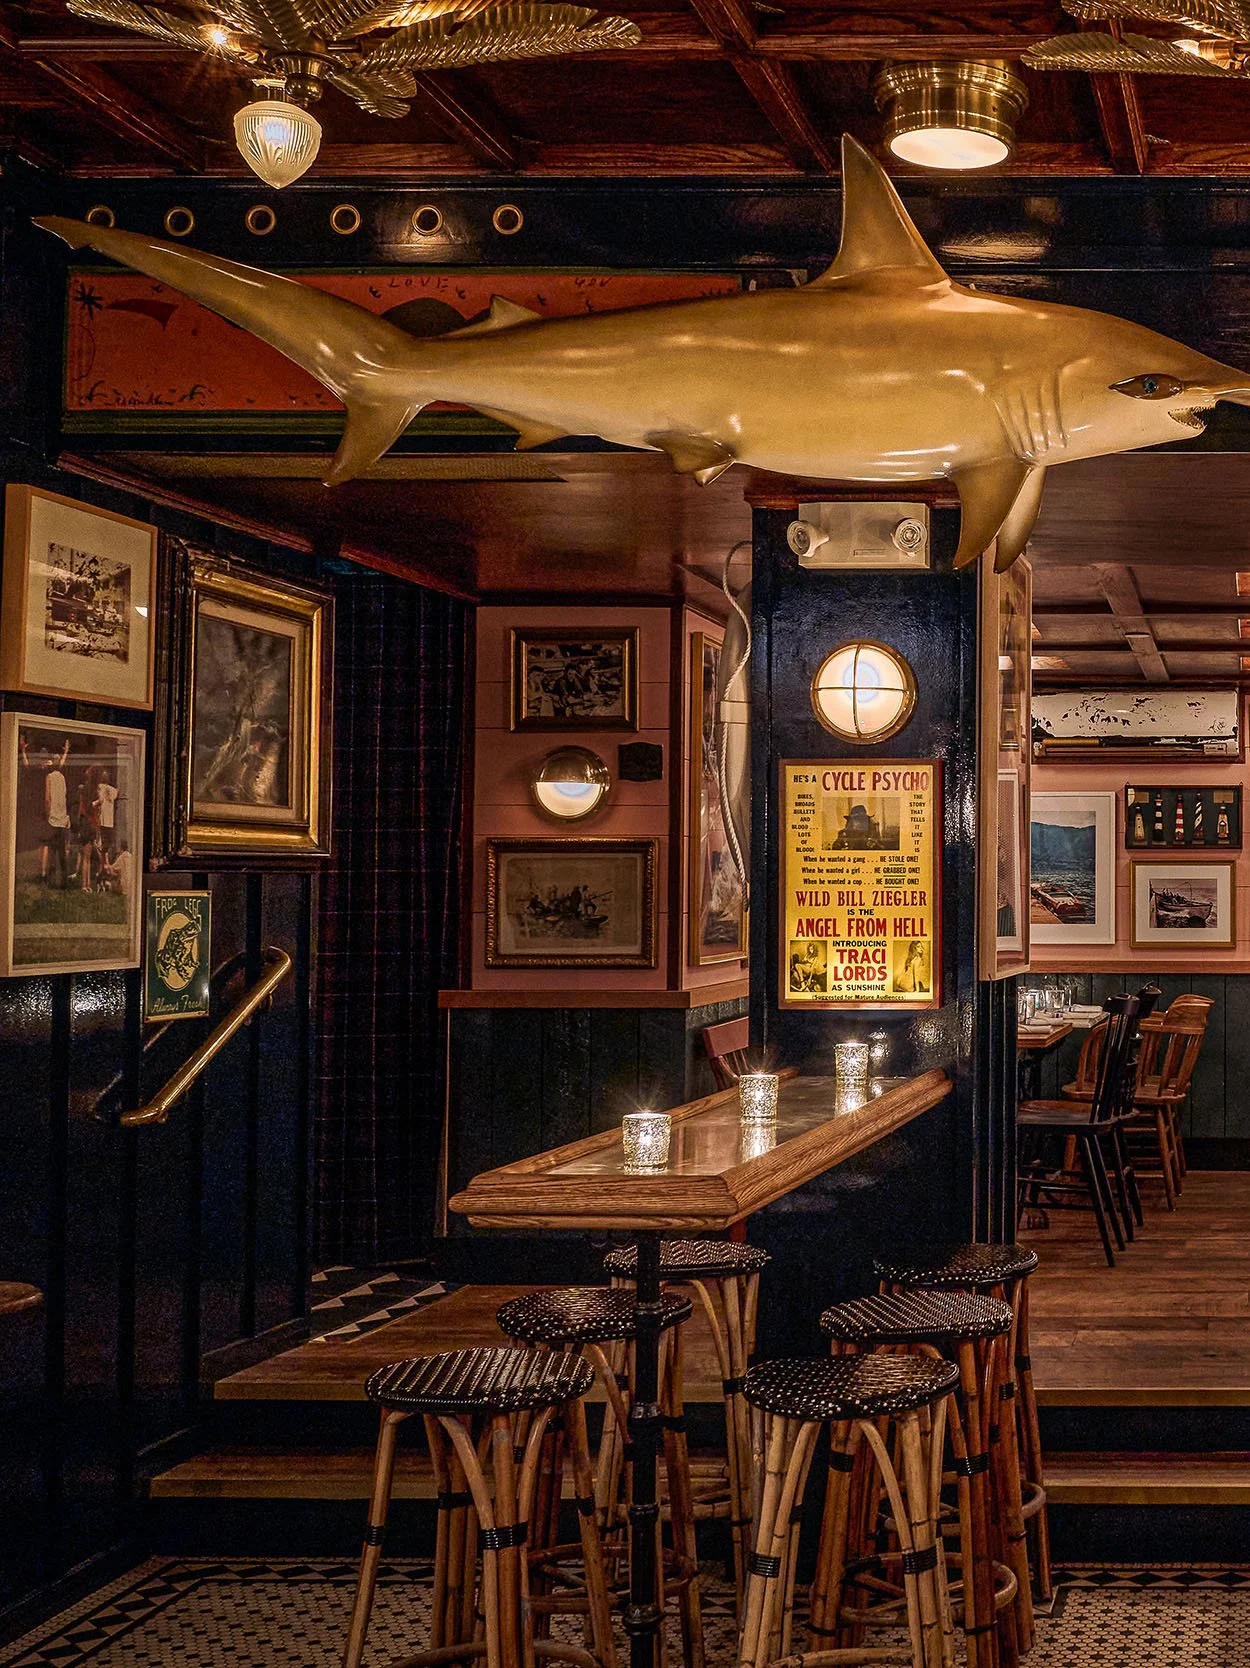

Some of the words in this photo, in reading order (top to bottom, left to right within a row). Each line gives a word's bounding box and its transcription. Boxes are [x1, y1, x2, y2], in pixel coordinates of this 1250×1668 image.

[389, 275, 449, 290] LOVE
[793, 774, 809, 783] HE'S
[811, 774, 817, 783] A
[822, 771, 866, 791] CYCLE
[872, 771, 930, 791] PSYCHO
[803, 855, 817, 863] When
[819, 855, 826, 863] he
[827, 855, 846, 863] wanted
[852, 856, 866, 864] gang
[880, 855, 887, 863] HE
[888, 855, 905, 863] STOLE
[906, 855, 919, 863] ONE!
[801, 866, 815, 874] When
[817, 866, 824, 874] he
[825, 866, 844, 874] wanted
[851, 866, 861, 875] girl
[874, 866, 881, 874] HE
[883, 866, 907, 874] GRABBED
[908, 866, 921, 874] ONE!
[852, 879, 863, 887] cop
[795, 891, 831, 907] WILD
[837, 891, 866, 907] BILL
[872, 891, 927, 907] ZIEGLER
[155, 897, 177, 927] FROG
[184, 897, 202, 928] LEGS
[795, 918, 841, 938] ANGEL
[847, 918, 887, 937] FROM
[893, 918, 928, 937] HELL
[836, 949, 886, 964] TRACI
[834, 966, 888, 981] LORDS
[152, 997, 179, 1013] Always
